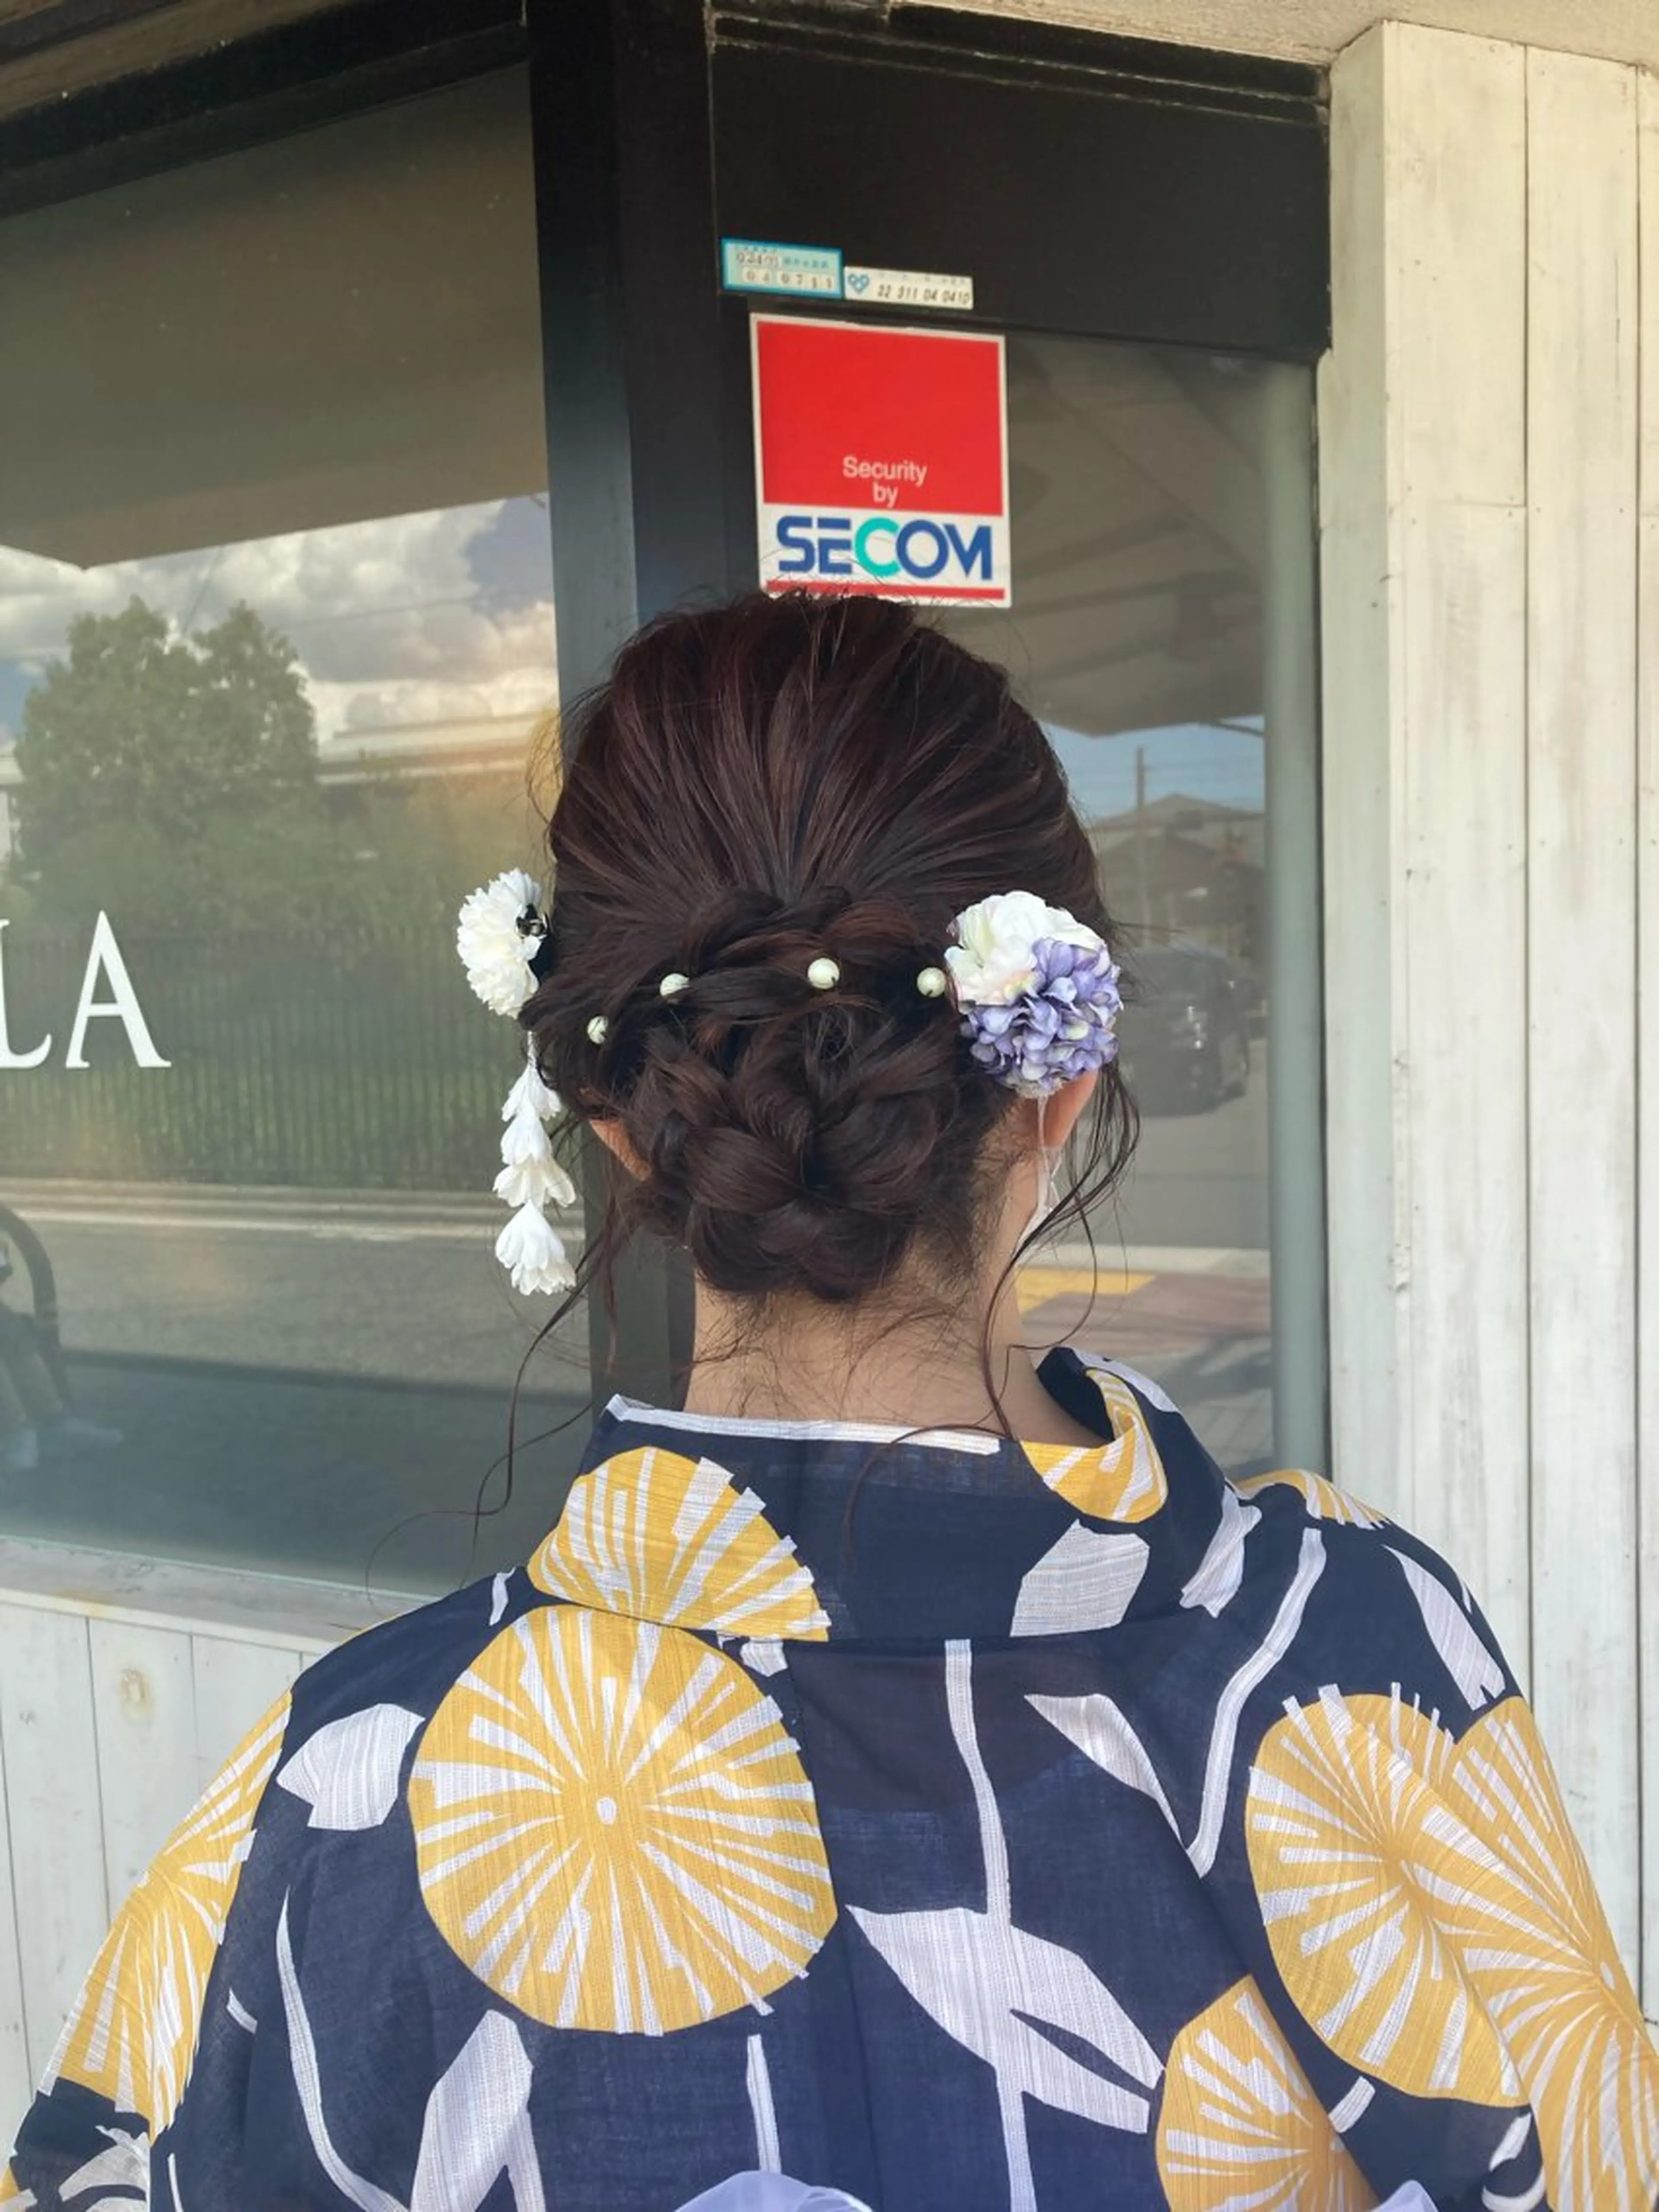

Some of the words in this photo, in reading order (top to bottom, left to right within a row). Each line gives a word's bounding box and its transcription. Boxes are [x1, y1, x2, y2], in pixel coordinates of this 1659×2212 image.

[842, 454, 928, 486] Security
[872, 481, 898, 509] by
[776, 515, 992, 581] SECOM
